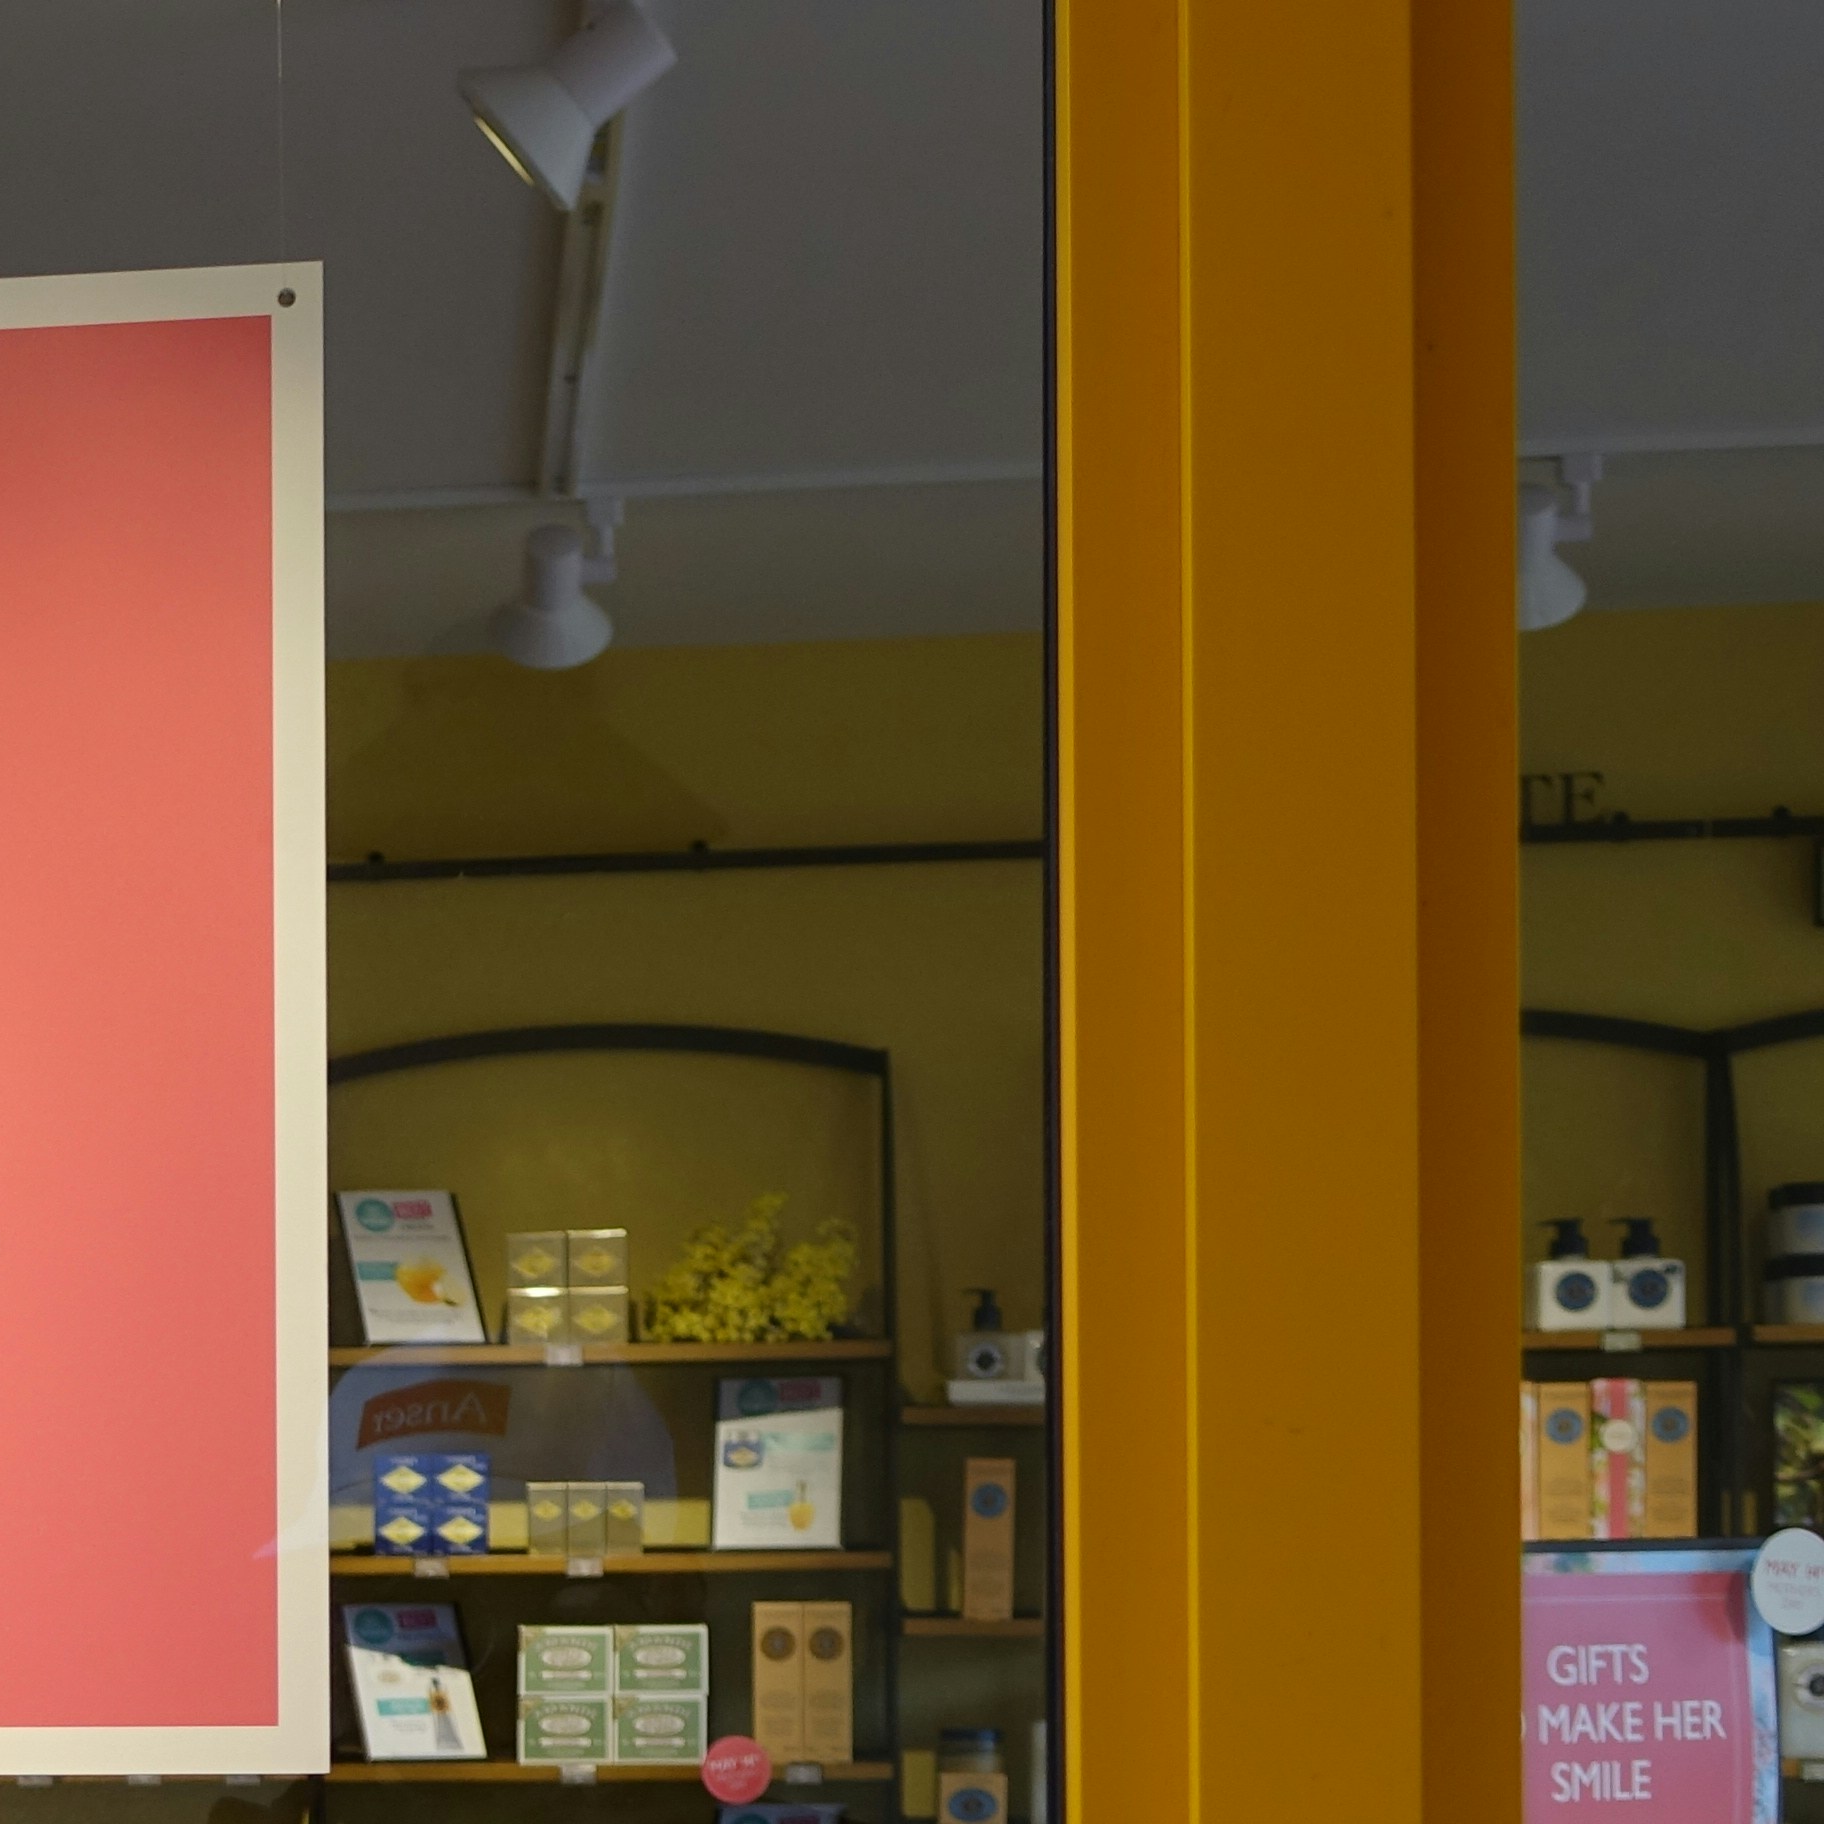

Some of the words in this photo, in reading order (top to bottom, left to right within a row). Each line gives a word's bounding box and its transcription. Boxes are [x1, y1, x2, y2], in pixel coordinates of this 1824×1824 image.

[1546, 1643, 1650, 1687] GIFTS
[1537, 1701, 1645, 1745] MAKE
[1653, 1699, 1728, 1741] HER
[1550, 1758, 1652, 1803] SMILE
